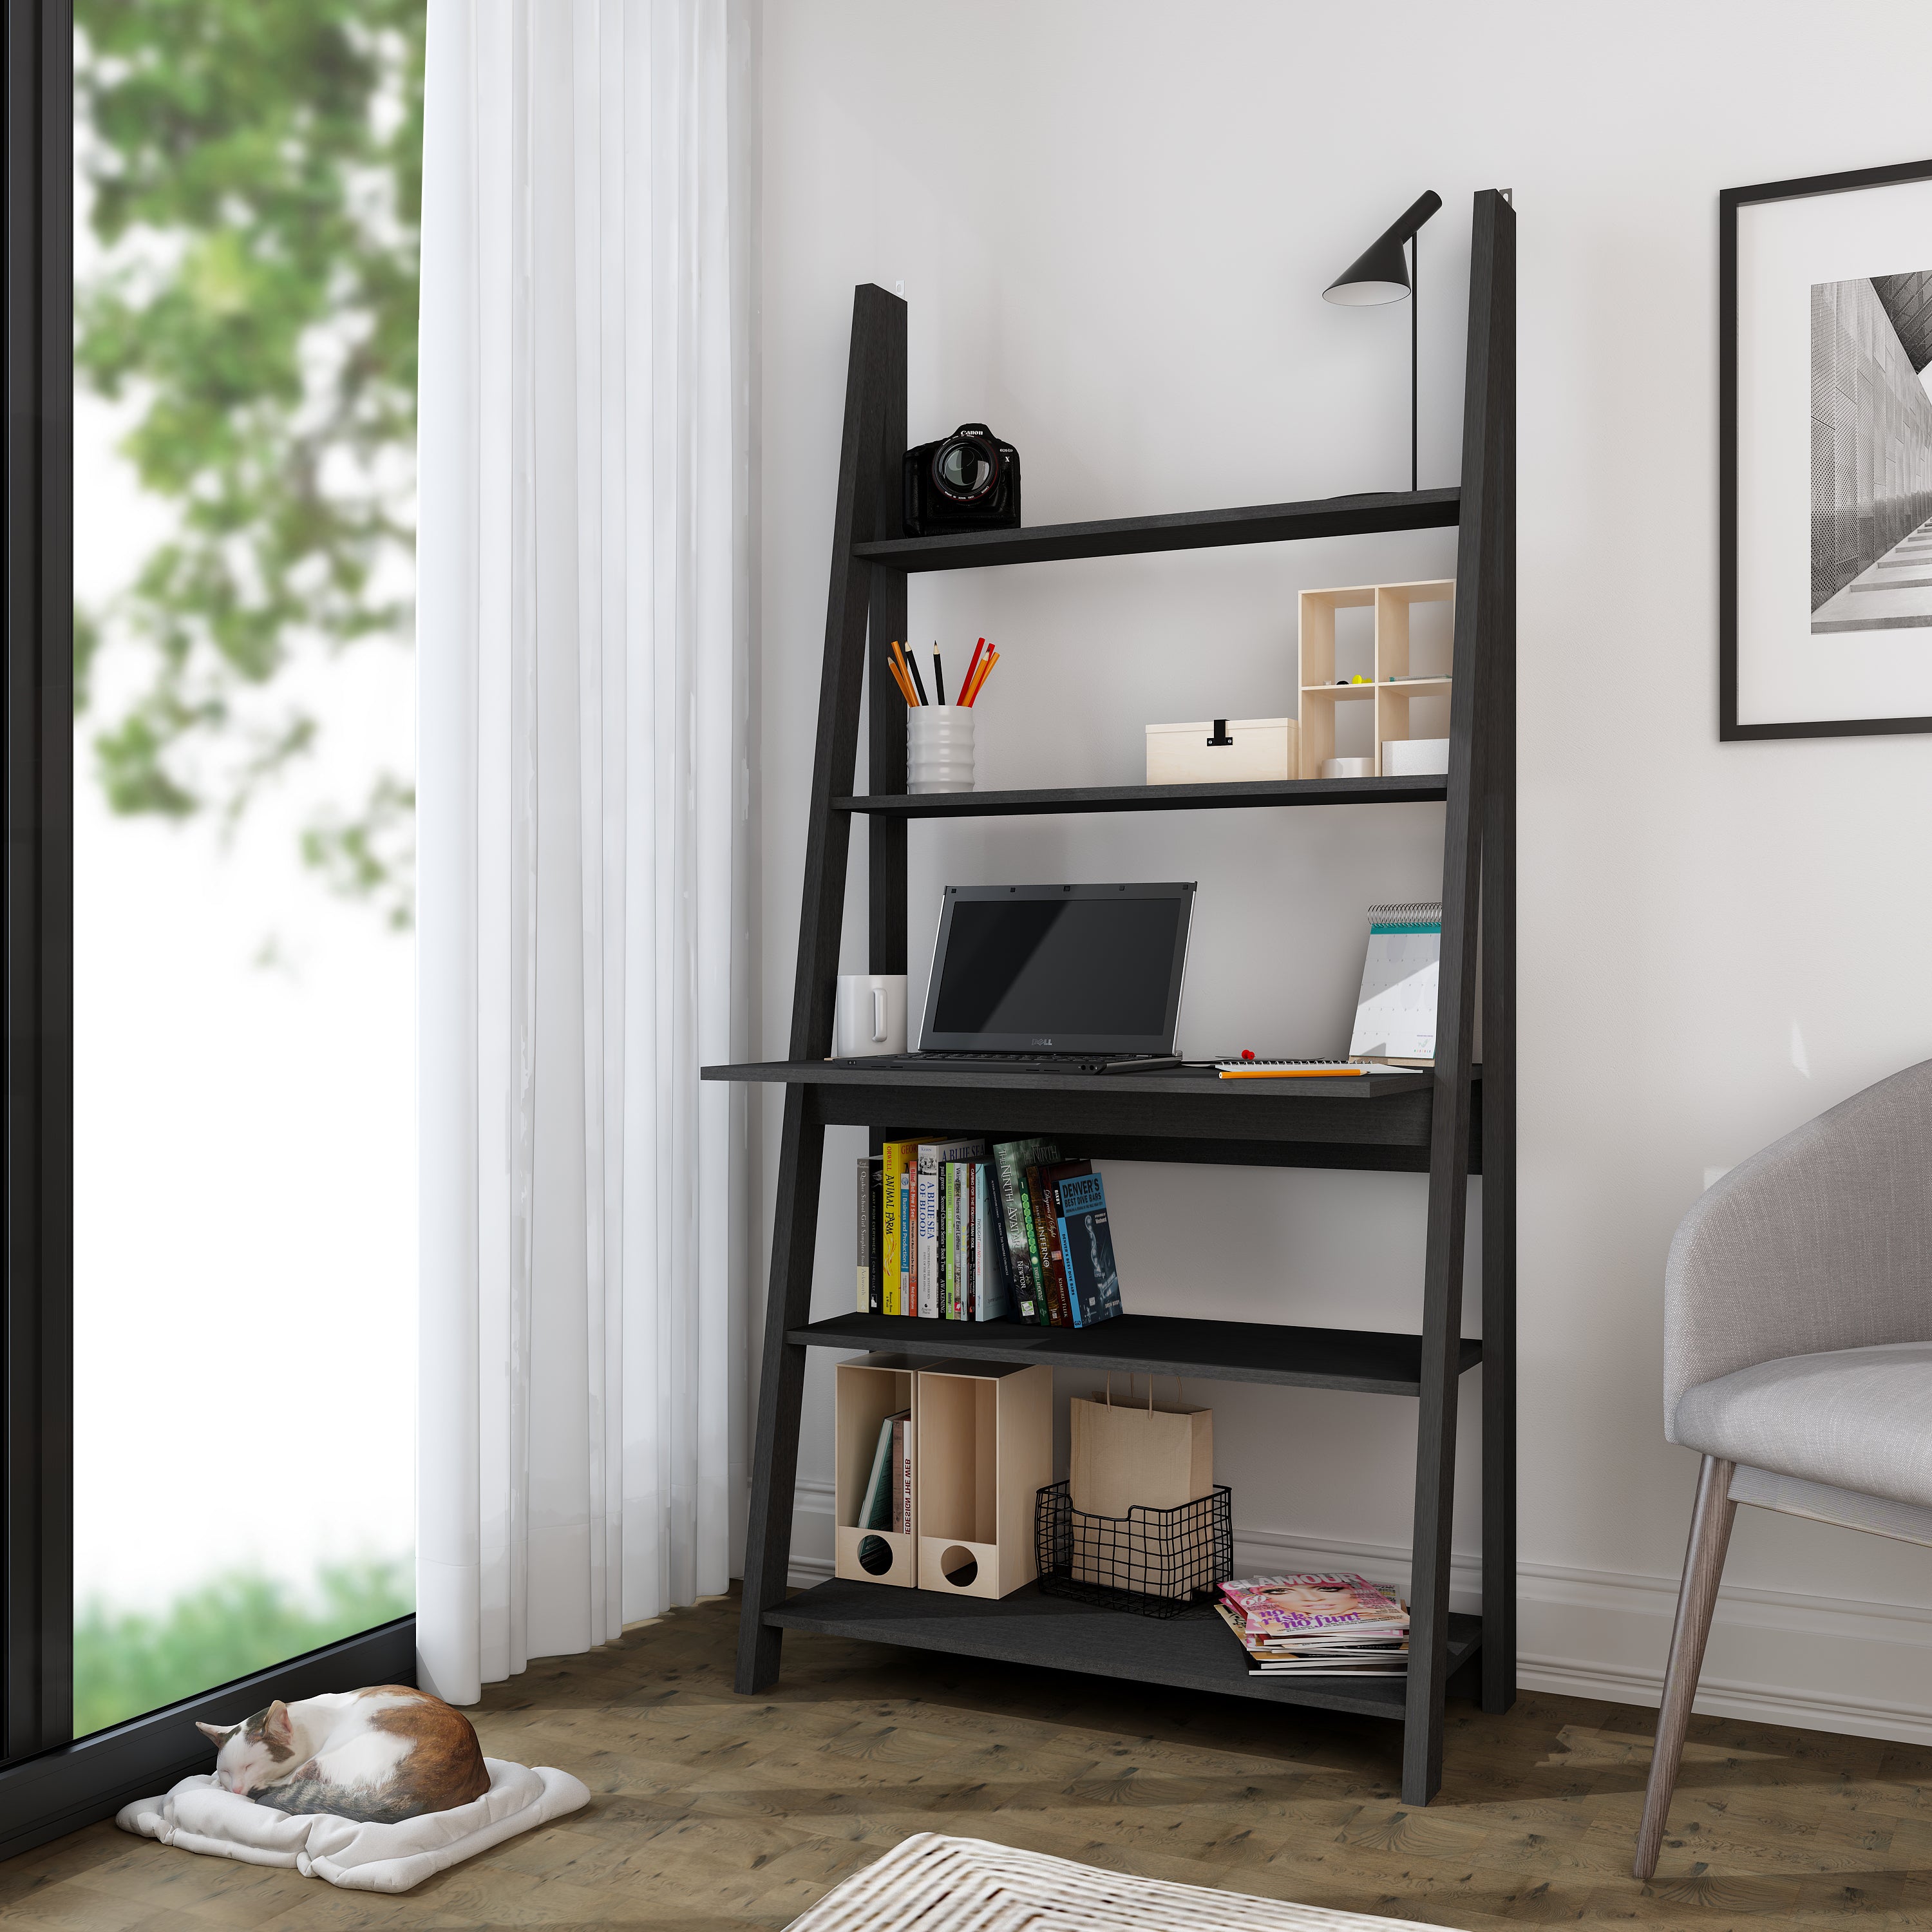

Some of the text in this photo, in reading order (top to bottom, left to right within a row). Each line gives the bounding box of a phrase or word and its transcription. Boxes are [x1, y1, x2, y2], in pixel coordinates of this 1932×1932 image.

[902, 1144, 918, 1154] GEOR
[942, 1150, 947, 1161] A
[1032, 1144, 1057, 1164] NINTH
[920, 1184, 925, 1195] OF
[1062, 1178, 1100, 1198] DENVER'S
[885, 1174, 895, 1235] ANIMAL FARM
[998, 1149, 1021, 1248] THE NINTH AVATAR
[1043, 1189, 1052, 1215] Degrees
[1065, 1193, 1101, 1208] BEST DIVE BARS
[1047, 1220, 1056, 1238] Sight
[1038, 1226, 1050, 1267] INFERNO
[1016, 1260, 1027, 1289] NEWTON
[1058, 1278, 1066, 1302] KIMBERLY
[1222, 1573, 1362, 1591] GLAMOUR
[1240, 1595, 1267, 1606] 60
[1259, 1609, 1285, 1618] no
[1281, 1618, 1312, 1629] no
[1314, 1612, 1361, 1629] fun!
